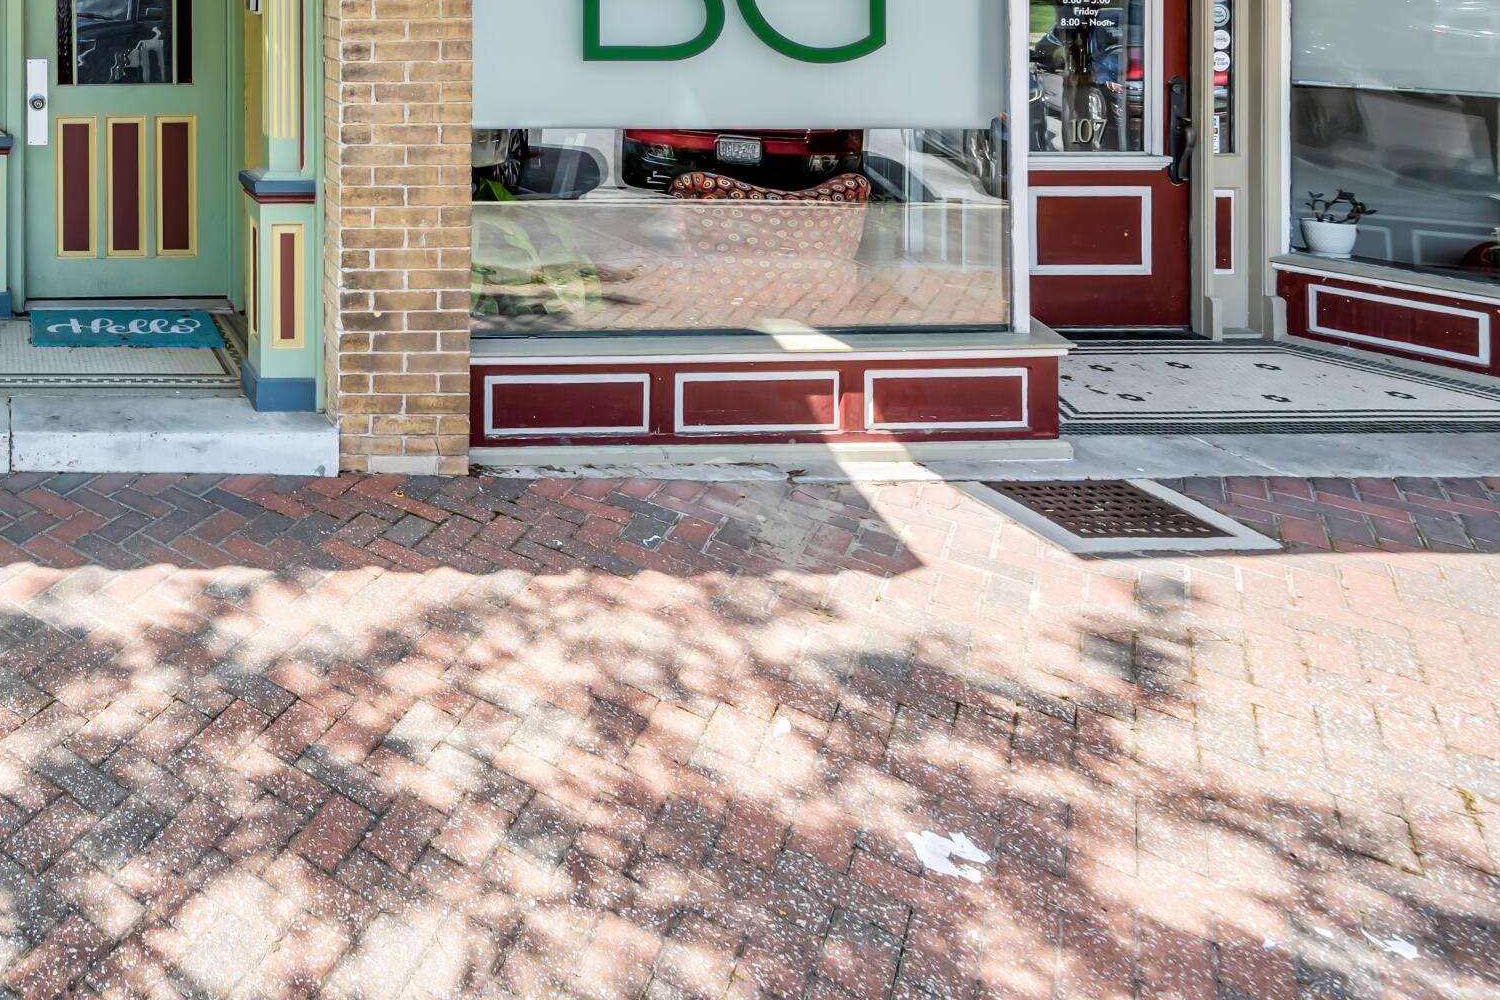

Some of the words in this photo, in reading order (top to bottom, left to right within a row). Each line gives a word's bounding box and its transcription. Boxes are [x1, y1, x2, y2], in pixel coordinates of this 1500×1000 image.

[1073, 7, 1100, 17] Friday
[1060, 18, 1080, 26] 8:00
[1069, 118, 1108, 145] 107
[46, 317, 201, 334] Hello
